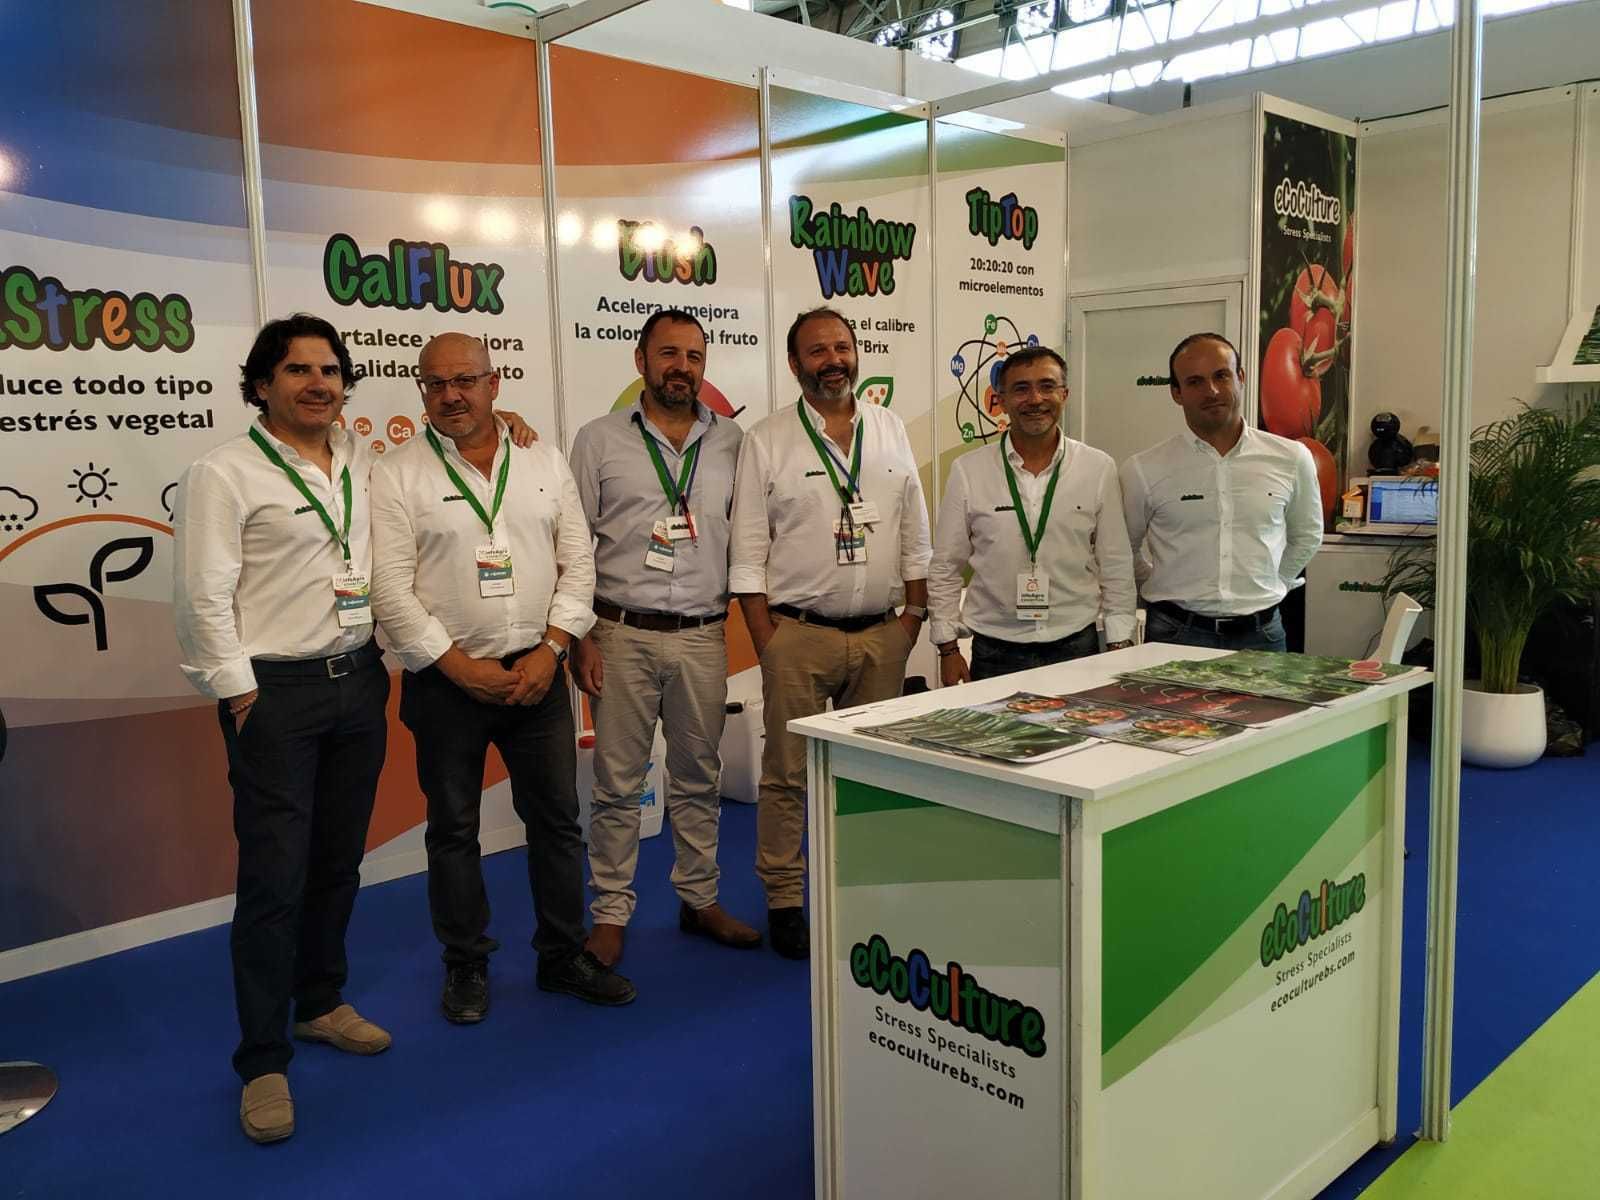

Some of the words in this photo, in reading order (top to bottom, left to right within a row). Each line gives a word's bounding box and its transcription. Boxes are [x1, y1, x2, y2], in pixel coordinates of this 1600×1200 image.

[965, 186, 1039, 251] TipTop
[1274, 177, 1341, 225] eCoCulture
[789, 195, 917, 261] Rainbow
[323, 233, 505, 315] CalFlux
[813, 246, 896, 300] Wave
[969, 257, 1014, 274] 20:20:20
[1016, 265, 1035, 276] con
[959, 280, 1044, 297] microelementos
[0, 265, 196, 353] Stress
[597, 296, 664, 315] Acelera
[683, 303, 740, 322] mejora
[860, 317, 872, 331] el
[875, 318, 916, 333] calibre
[341, 328, 423, 348] rtalece
[575, 323, 592, 340] la
[596, 324, 643, 342] color
[719, 329, 759, 346] fruto
[951, 360, 964, 374] Mg
[72, 374, 146, 396] todo
[154, 374, 214, 401] tipo
[106, 408, 215, 436] vegetal
[355, 421, 370, 432] Ca
[389, 423, 412, 439] Ca
[962, 428, 974, 439] Zn
[1260, 872, 1366, 968] eCoCulture
[1275, 960, 1305, 986] Stress
[1307, 931, 1352, 968] Specialists
[850, 933, 1047, 1058] eCoCulture
[1270, 950, 1356, 1012] ecoculturebs.com
[875, 1005, 922, 1039] Stress
[927, 1027, 1017, 1080] Specialists
[868, 1030, 1025, 1110] ecoculturebs.com
